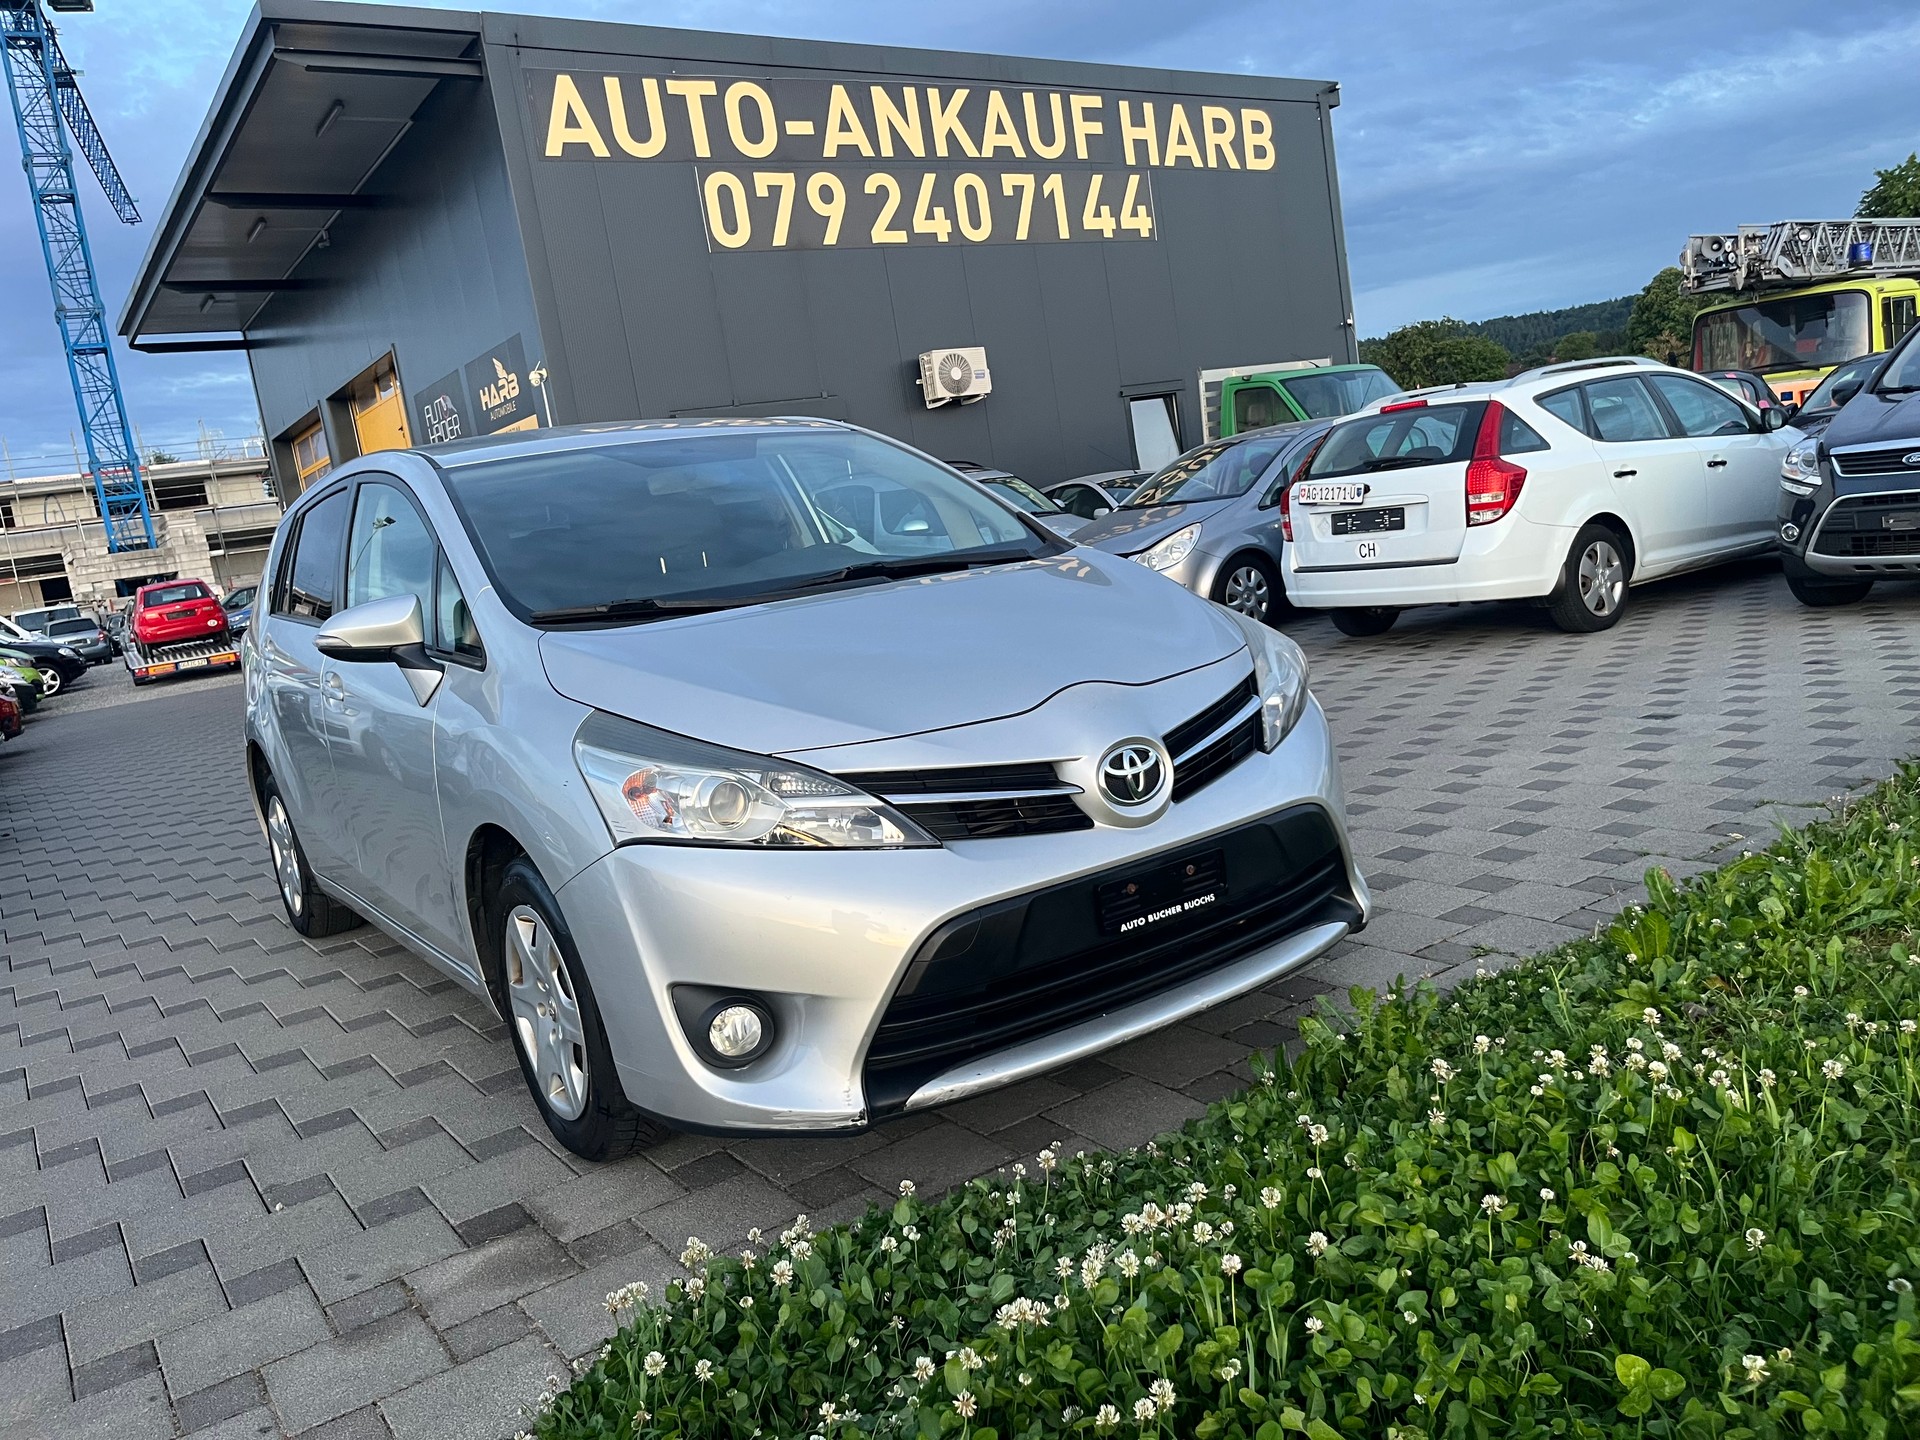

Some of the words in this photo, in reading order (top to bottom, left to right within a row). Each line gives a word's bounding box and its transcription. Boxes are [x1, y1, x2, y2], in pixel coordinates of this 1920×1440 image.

[544, 74, 1104, 160] AUTO-ANKAUF
[1118, 100, 1277, 171] HARB
[703, 170, 847, 249] 079
[863, 172, 993, 244] 240
[479, 372, 520, 411] HARB
[1358, 542, 1376, 559] CH
[1120, 917, 1146, 933] AUTO
[1147, 904, 1182, 923] BUCHER
[1183, 893, 1216, 911] BUOCHS
